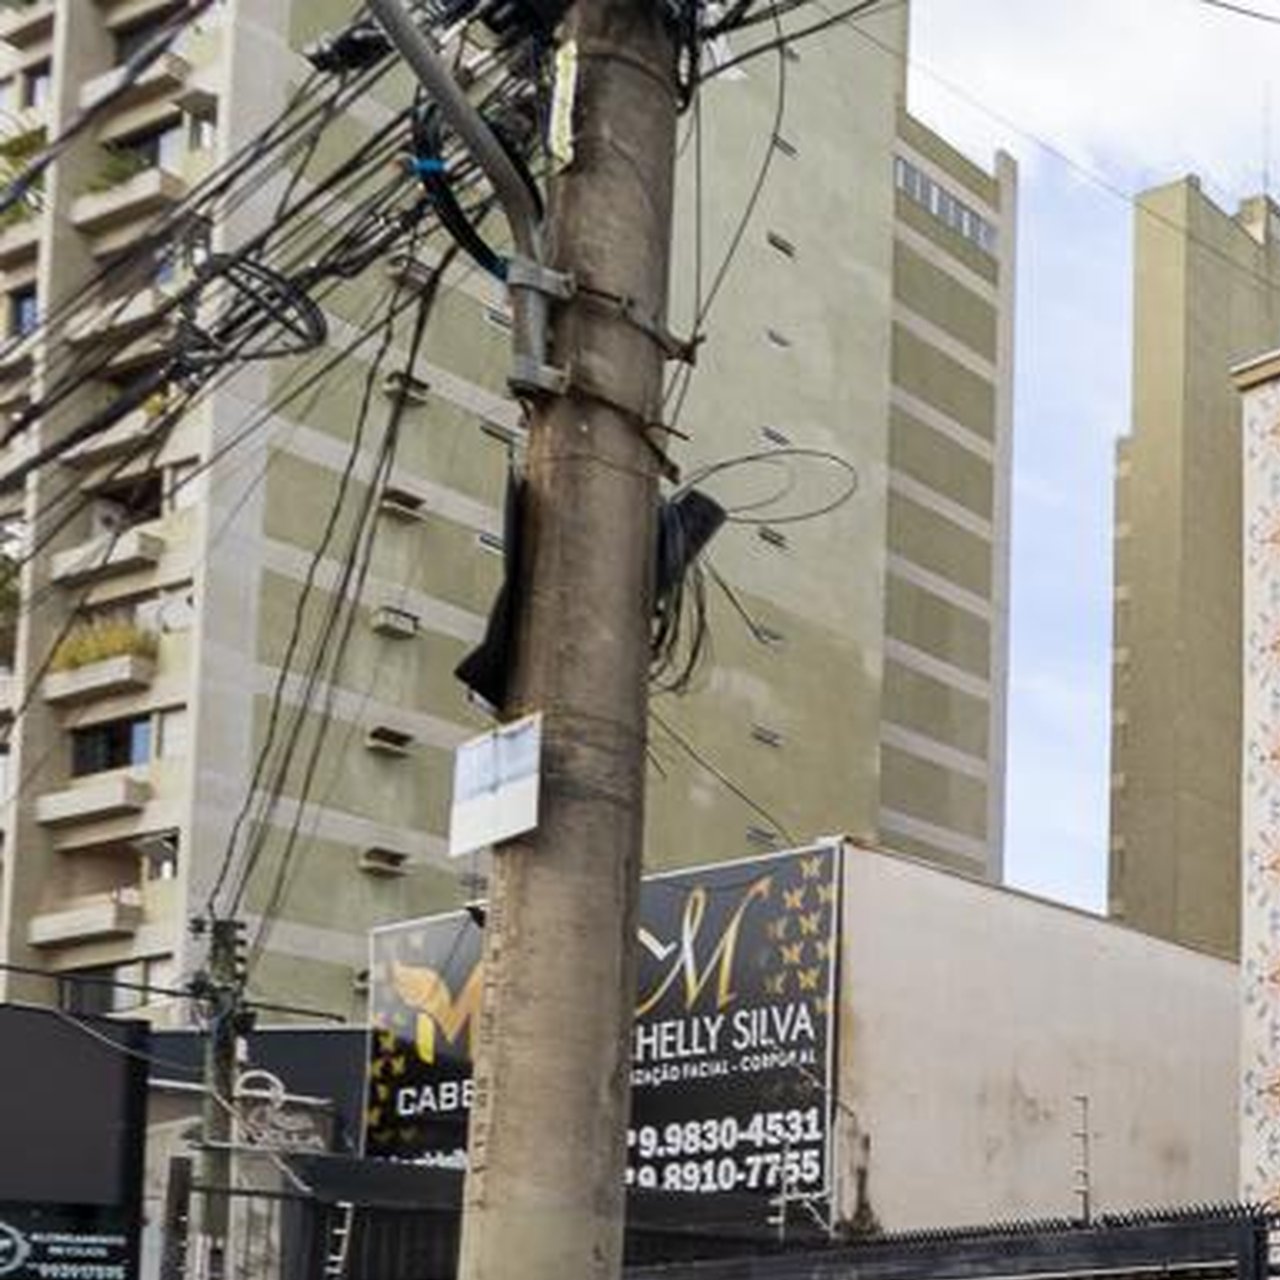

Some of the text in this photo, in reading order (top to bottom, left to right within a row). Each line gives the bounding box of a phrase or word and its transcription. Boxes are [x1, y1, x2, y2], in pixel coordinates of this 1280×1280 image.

[634, 1003, 815, 1061] HELLY SILVA
[397, 1079, 475, 1116] CABE
